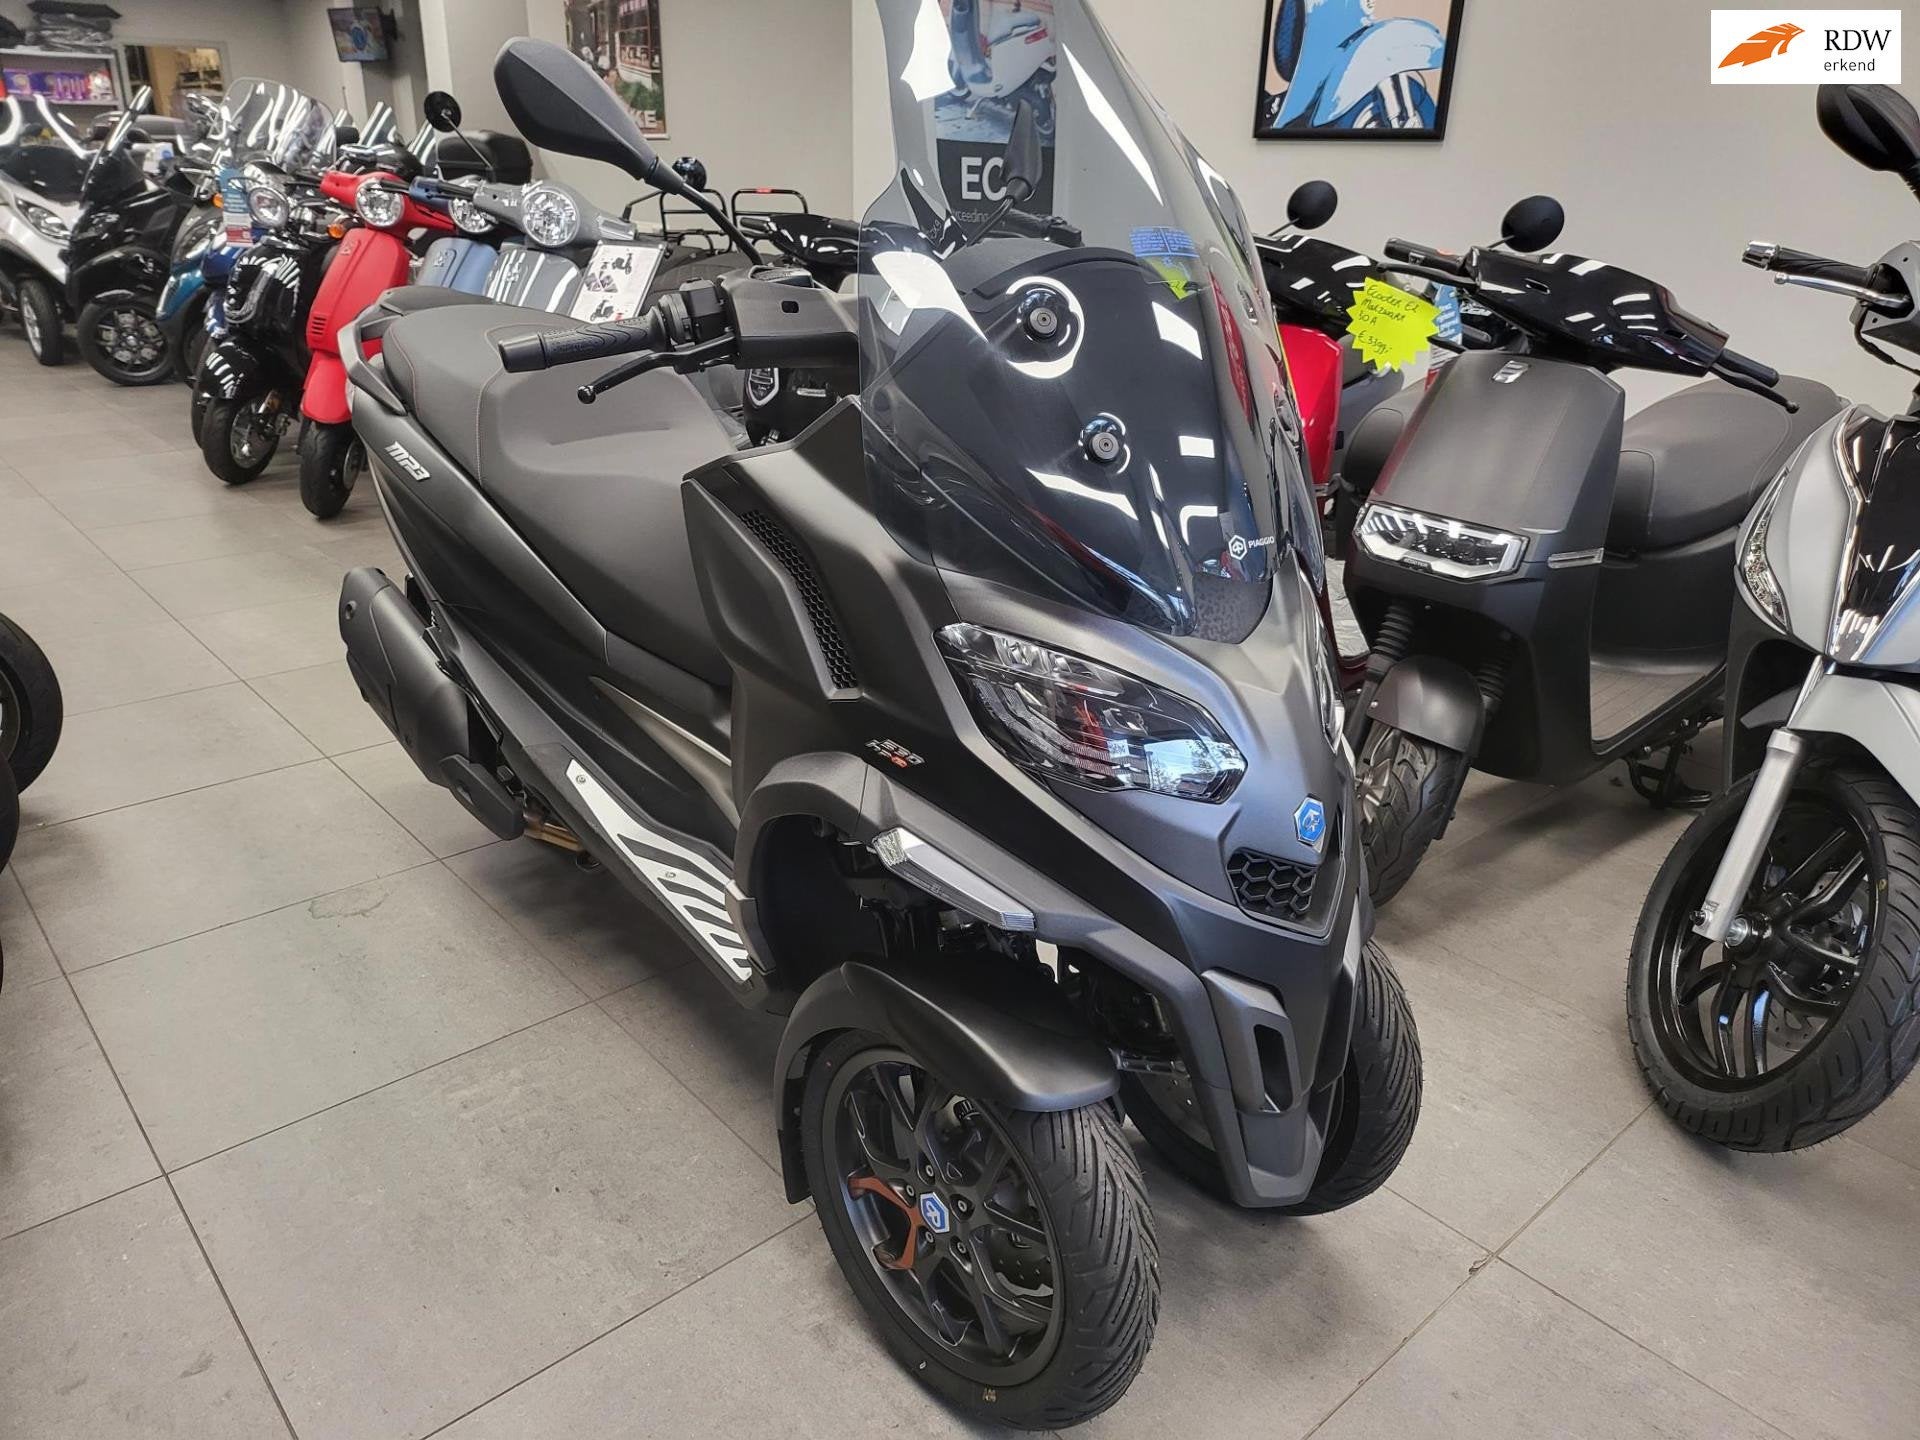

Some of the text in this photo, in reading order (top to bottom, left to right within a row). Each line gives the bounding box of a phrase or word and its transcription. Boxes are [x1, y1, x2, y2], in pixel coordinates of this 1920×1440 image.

[960, 156, 1036, 202] EC
[384, 441, 430, 480] MP3
[1248, 536, 1275, 549] PIAGGIO
